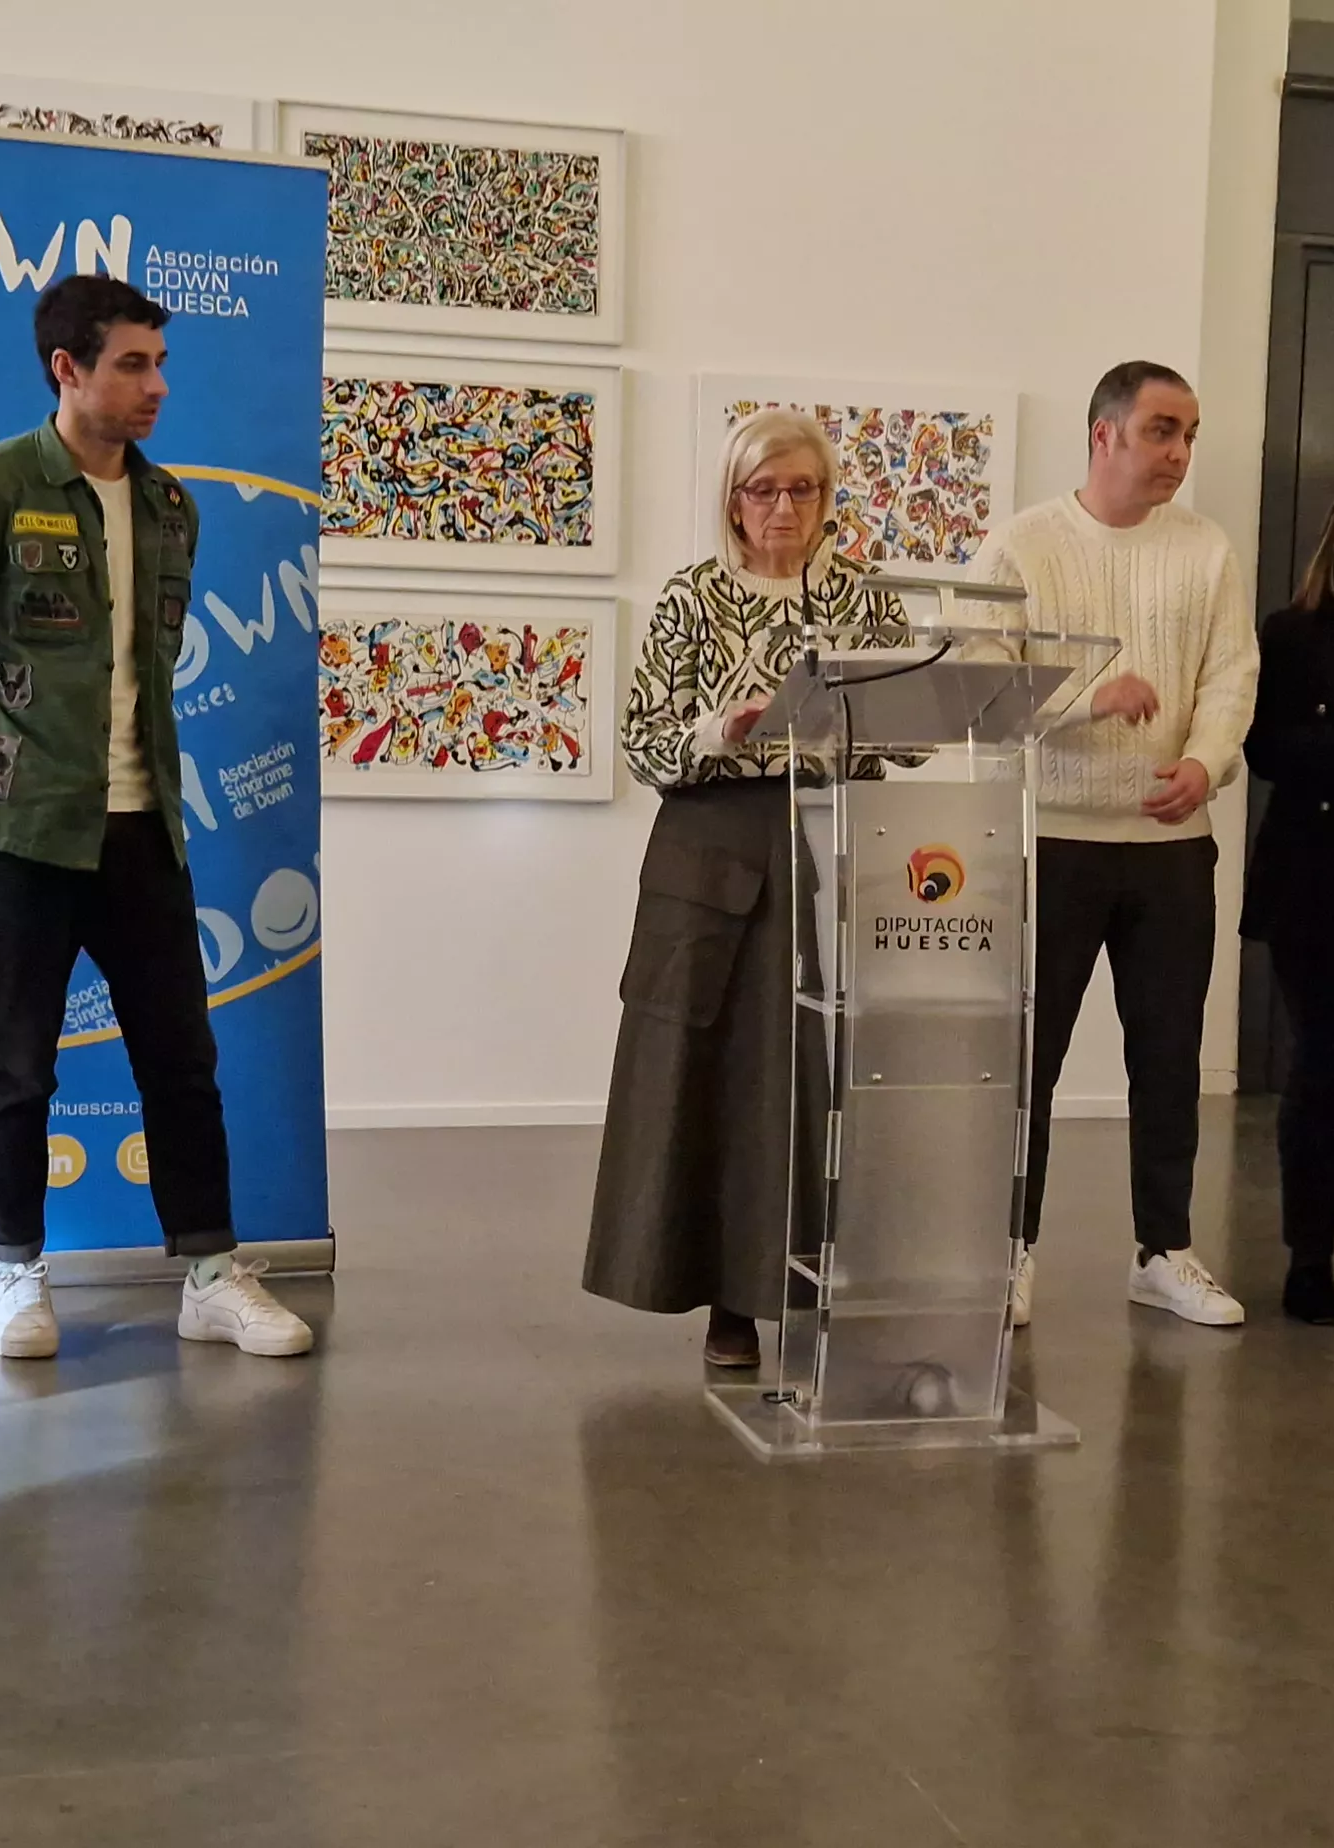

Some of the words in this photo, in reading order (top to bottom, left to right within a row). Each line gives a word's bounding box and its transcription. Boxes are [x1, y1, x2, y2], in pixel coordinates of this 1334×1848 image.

[146, 244, 279, 276] Asociación
[146, 267, 229, 293] DOWN
[146, 290, 249, 318] HUESCA
[218, 741, 296, 787] Asociación
[233, 800, 254, 820] de
[254, 782, 294, 810] Down
[875, 914, 993, 934] DIPUTACIÓN
[875, 935, 992, 951] HUESCA
[66, 980, 109, 1009] socia
